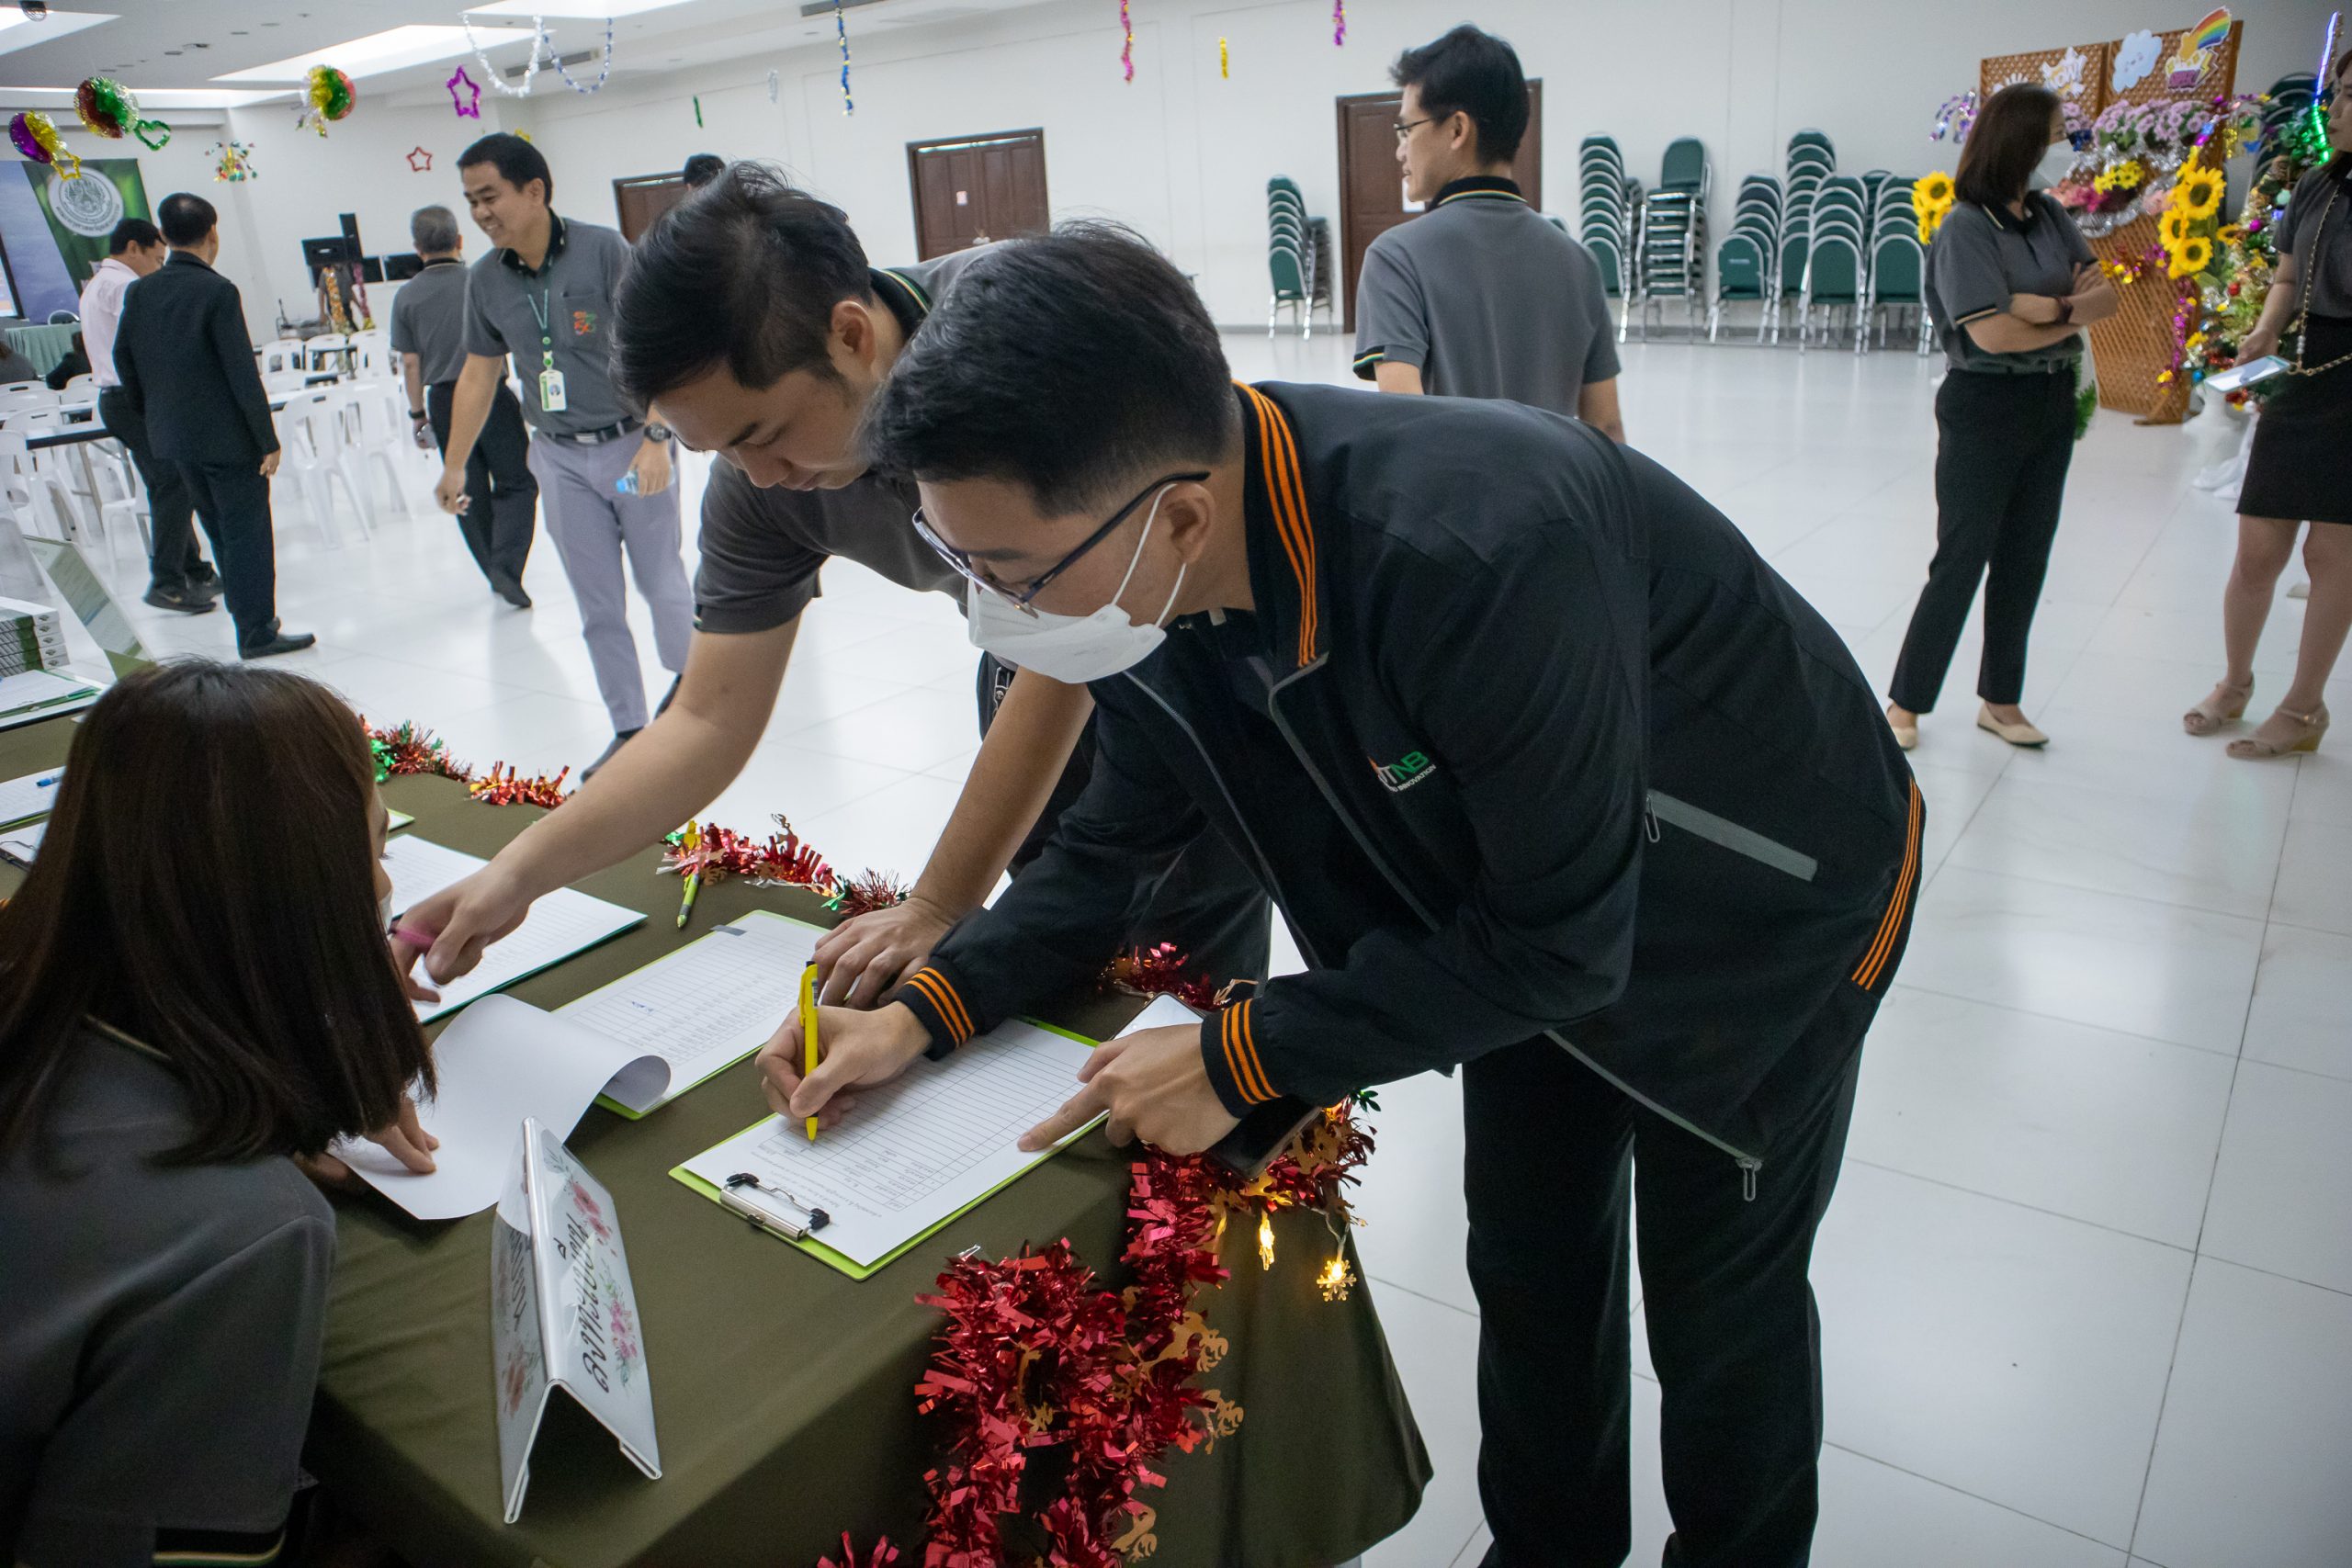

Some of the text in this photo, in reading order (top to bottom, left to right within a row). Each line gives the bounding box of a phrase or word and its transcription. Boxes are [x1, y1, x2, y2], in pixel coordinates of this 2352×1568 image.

[1396, 764, 1436, 791] INNOVATION
[554, 1213, 609, 1393] ลงทะเบียน
